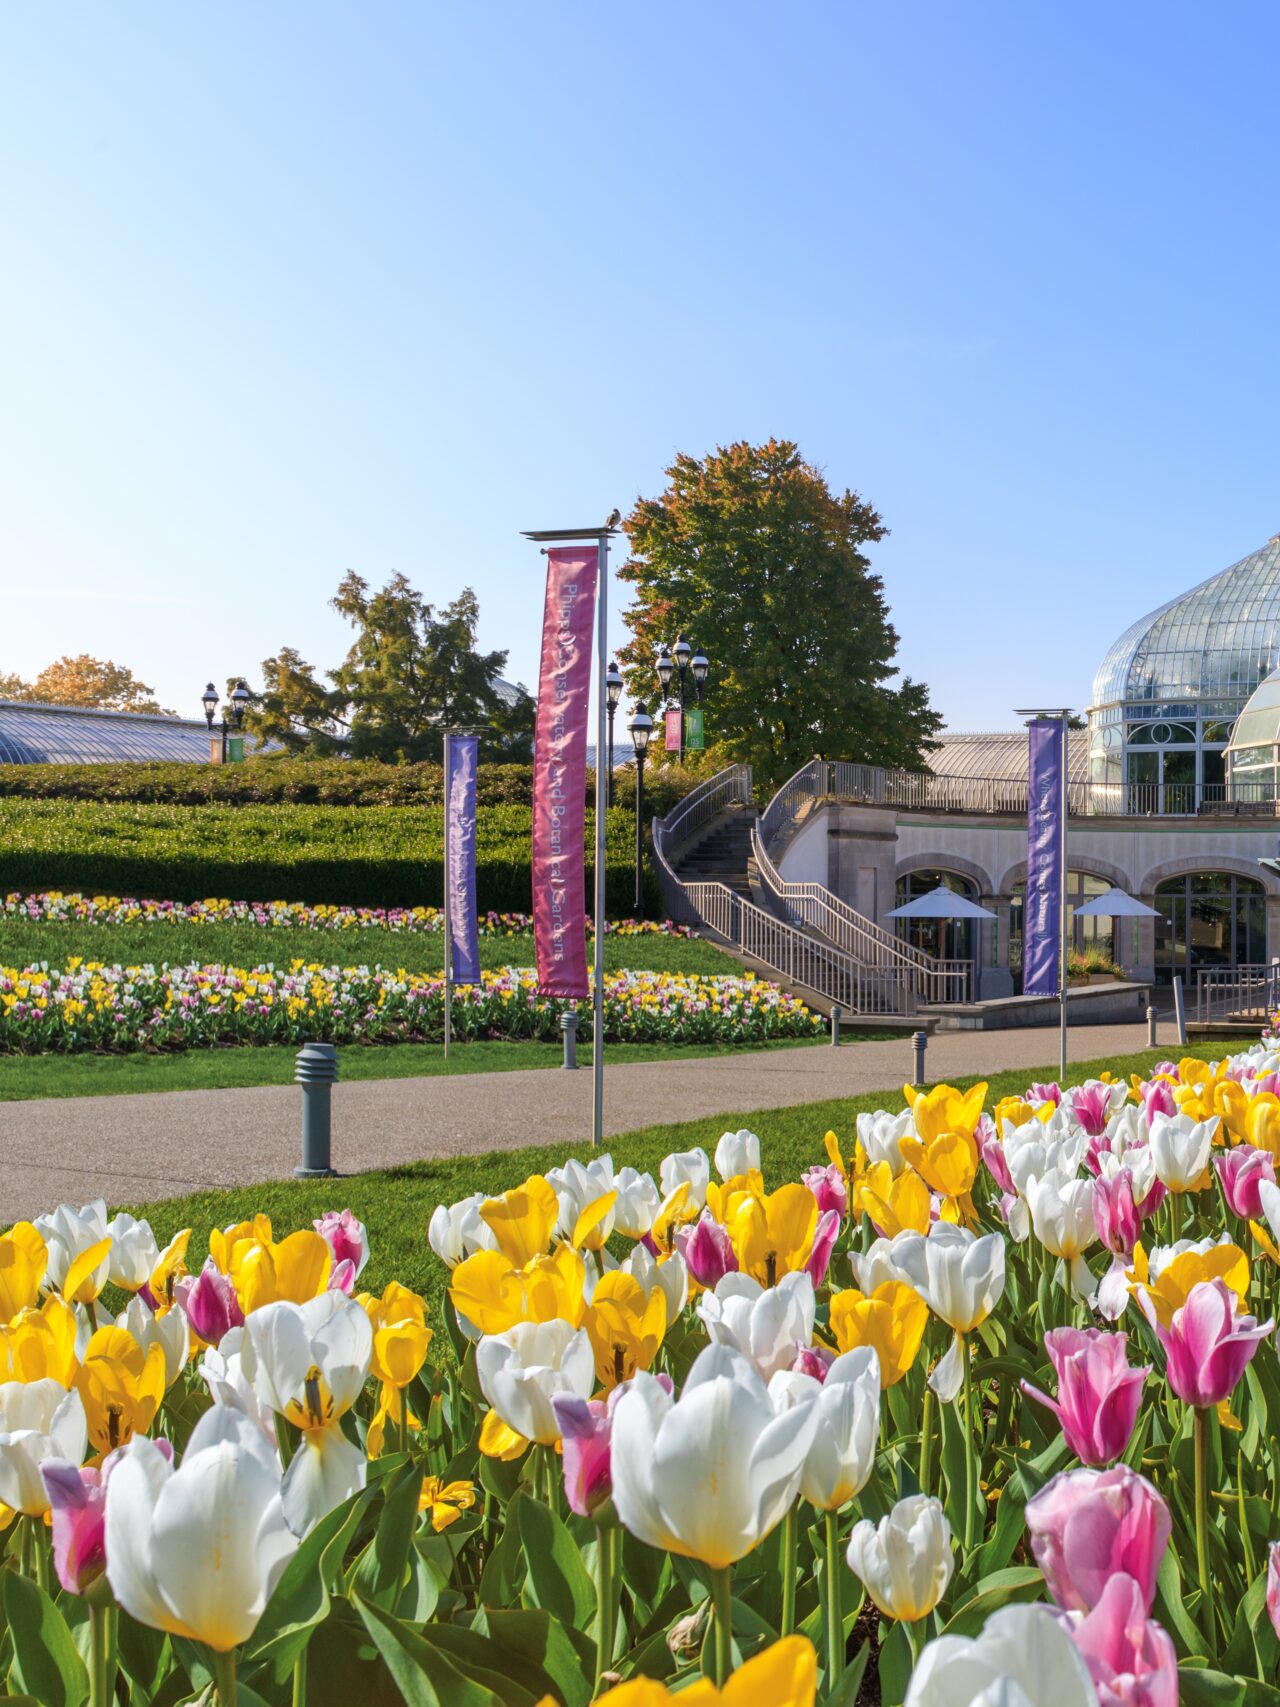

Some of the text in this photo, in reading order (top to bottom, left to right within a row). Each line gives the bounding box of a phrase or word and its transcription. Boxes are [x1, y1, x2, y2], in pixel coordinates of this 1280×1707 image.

[557, 583, 577, 636] Phipps
[551, 768, 566, 799] and
[1040, 771, 1051, 811] Where
[551, 805, 566, 883] Botanical
[1039, 854, 1049, 890] Comes
[552, 889, 566, 960] Gardens
[1035, 892, 1049, 941] Naturally
